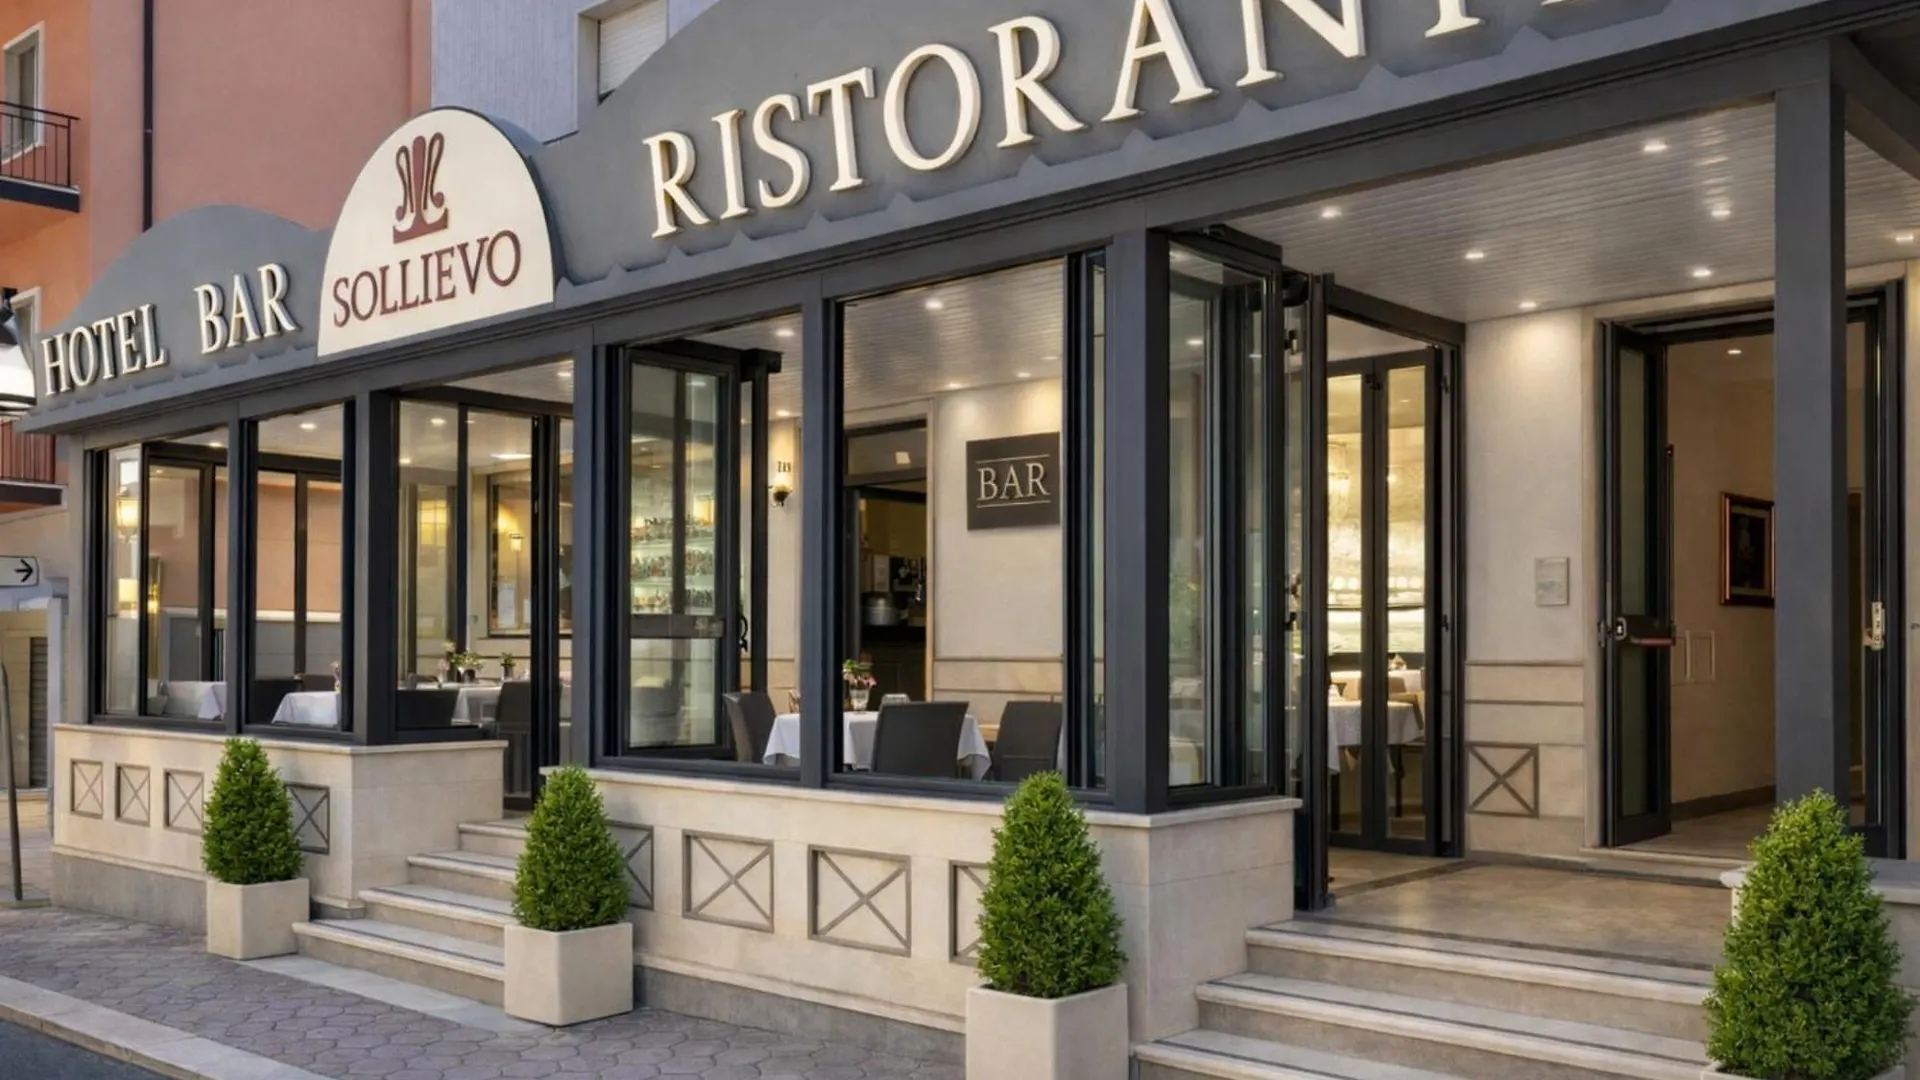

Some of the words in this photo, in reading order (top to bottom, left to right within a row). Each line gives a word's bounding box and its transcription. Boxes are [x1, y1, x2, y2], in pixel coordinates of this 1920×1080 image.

[642, 0, 1563, 239] RISTORAN
[40, 303, 170, 397] HOTEL
[194, 262, 302, 356] BAR
[333, 230, 521, 328] SOLLIEVO
[976, 462, 1052, 501] BAR
